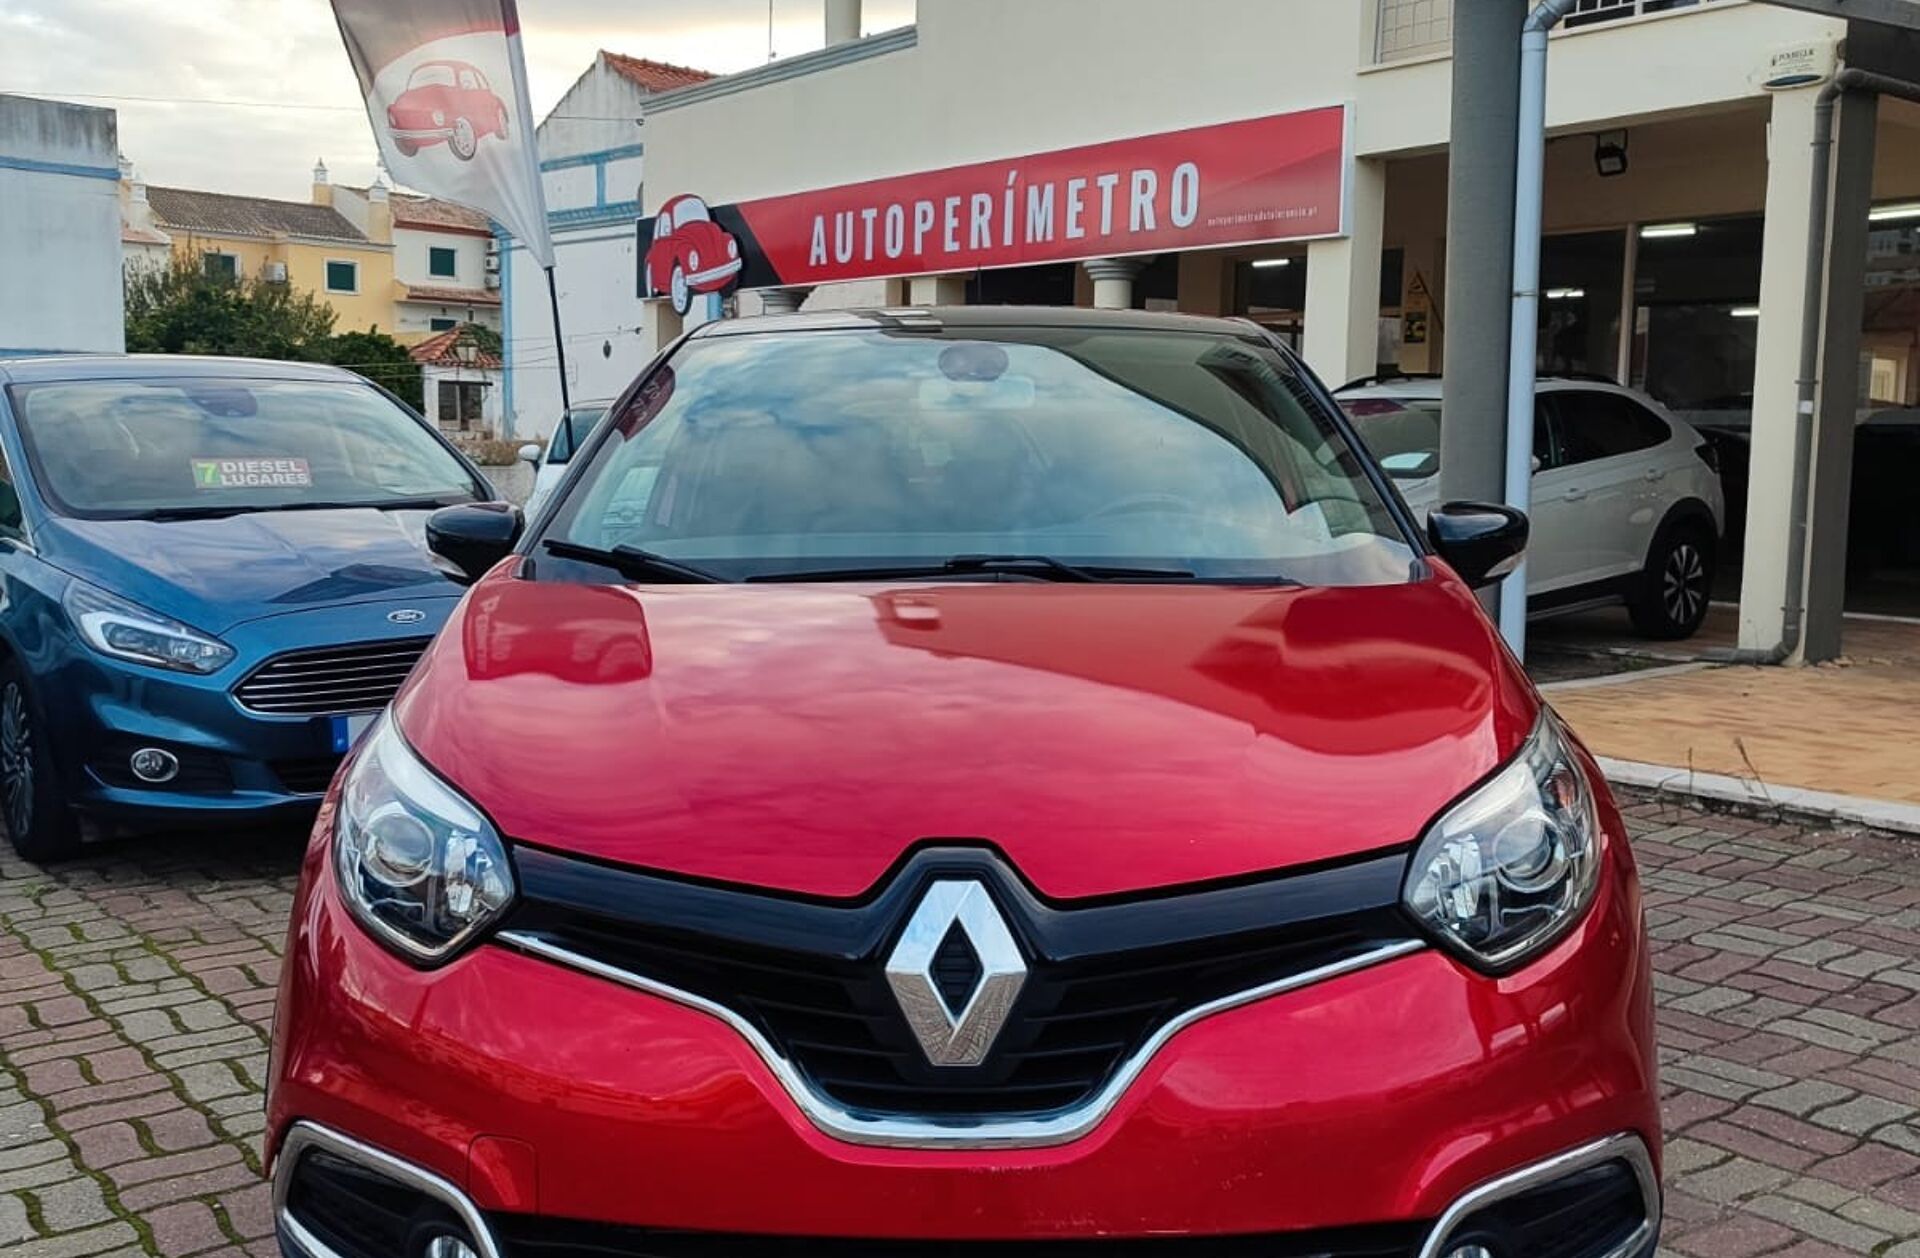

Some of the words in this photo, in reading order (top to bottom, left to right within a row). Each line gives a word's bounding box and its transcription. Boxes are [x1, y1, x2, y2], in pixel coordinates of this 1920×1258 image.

[808, 161, 1201, 267] AUTOPERÍMETRO
[196, 462, 218, 485] 7
[221, 460, 304, 473] DIESEL
[220, 472, 309, 486] LUGARES
